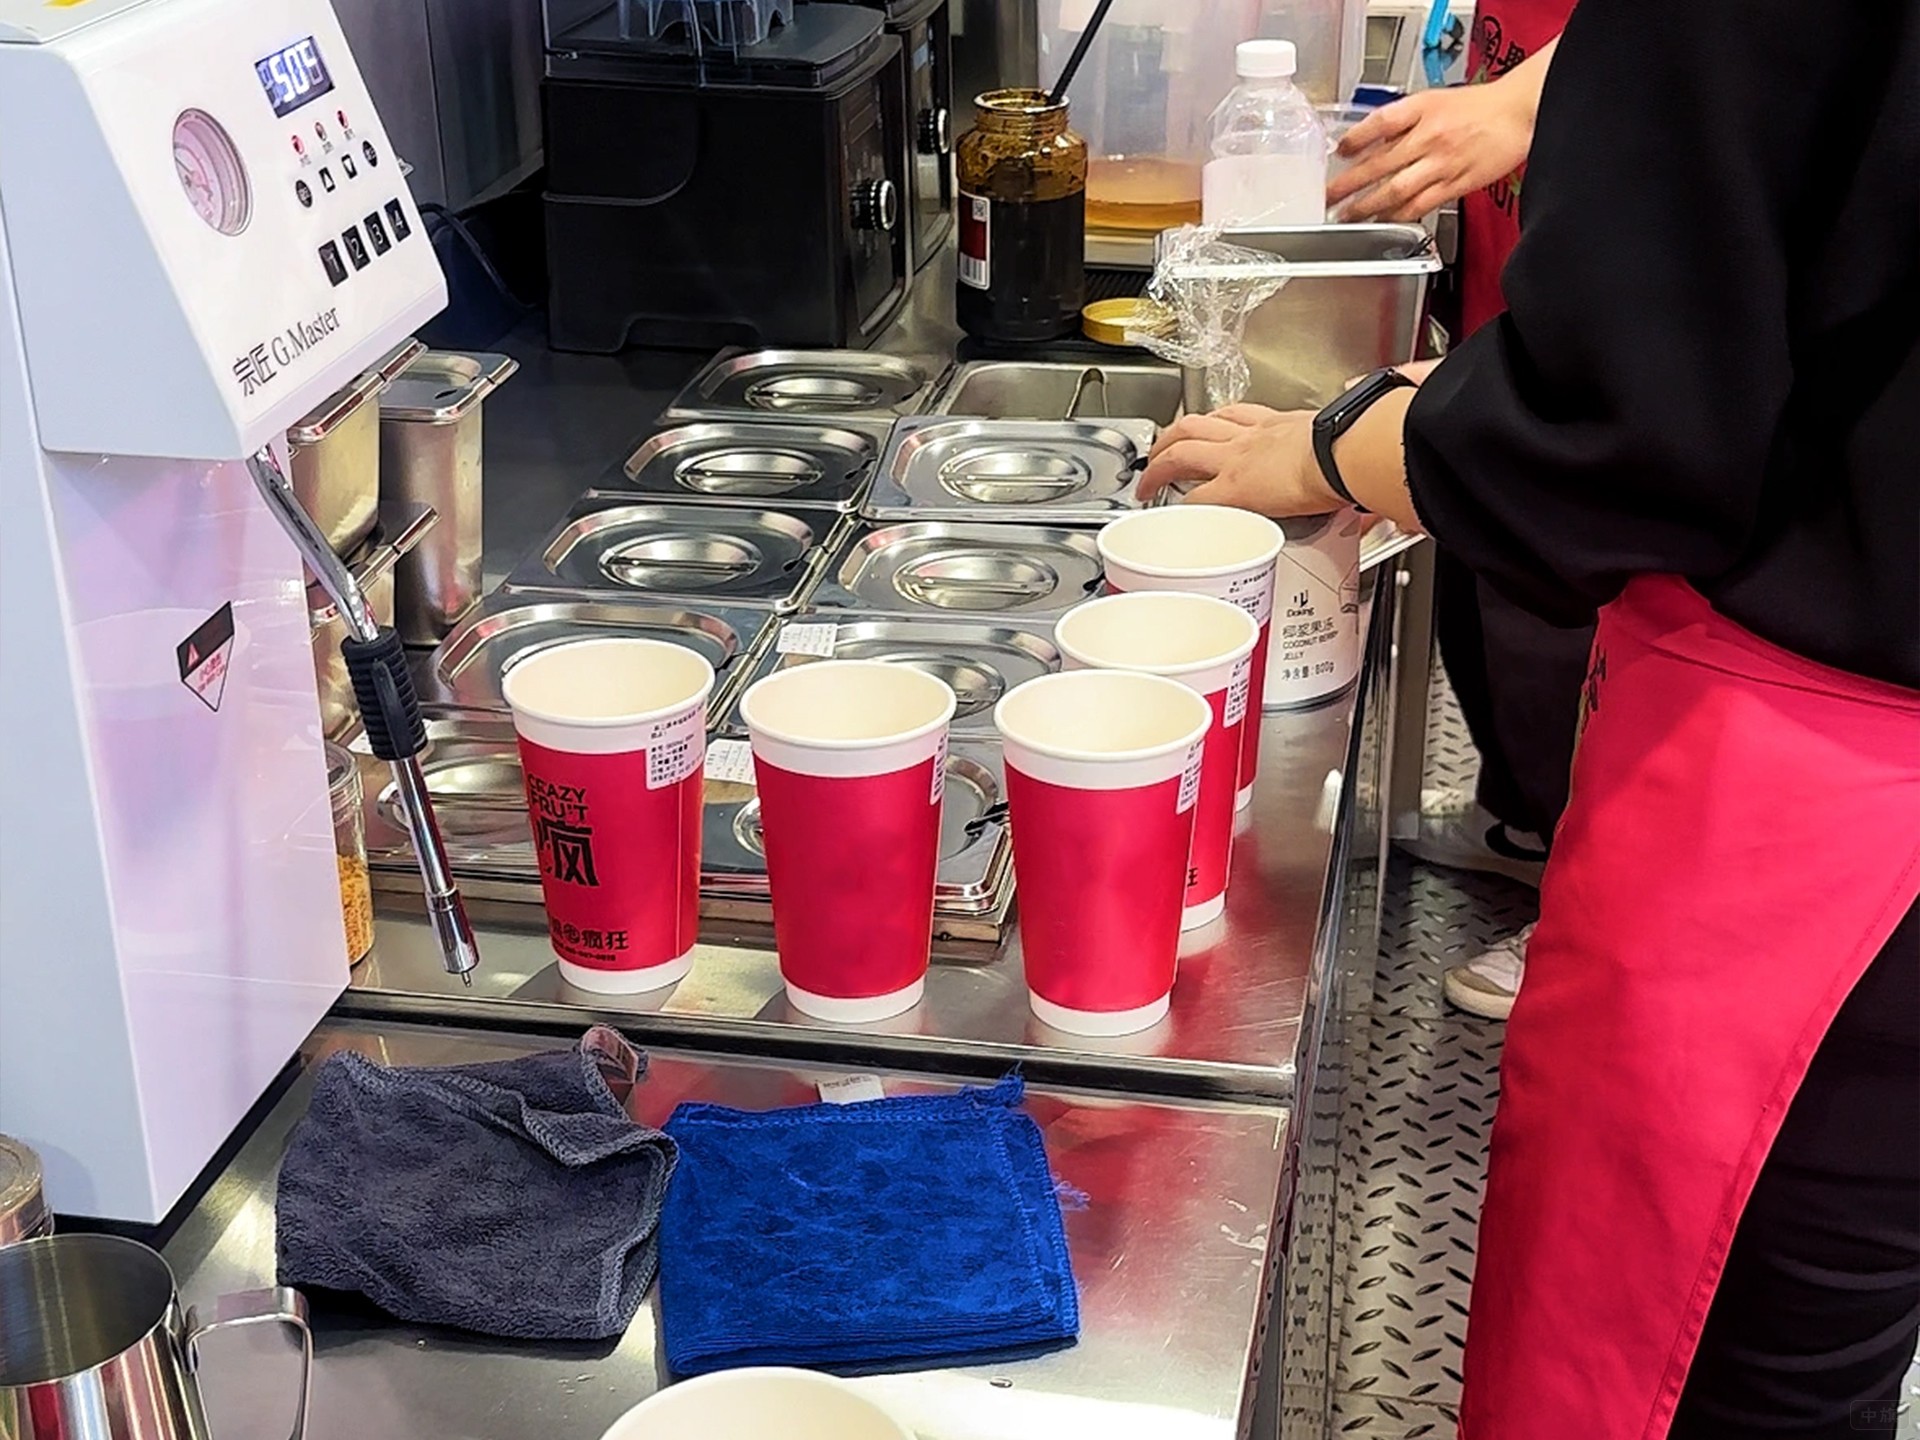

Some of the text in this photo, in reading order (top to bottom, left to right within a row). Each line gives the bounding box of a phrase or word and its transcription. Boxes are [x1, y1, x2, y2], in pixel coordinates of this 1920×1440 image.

[271, 307, 340, 367] G.Master
[232, 342, 278, 397] 宗匠
[527, 773, 587, 803] CRAZY
